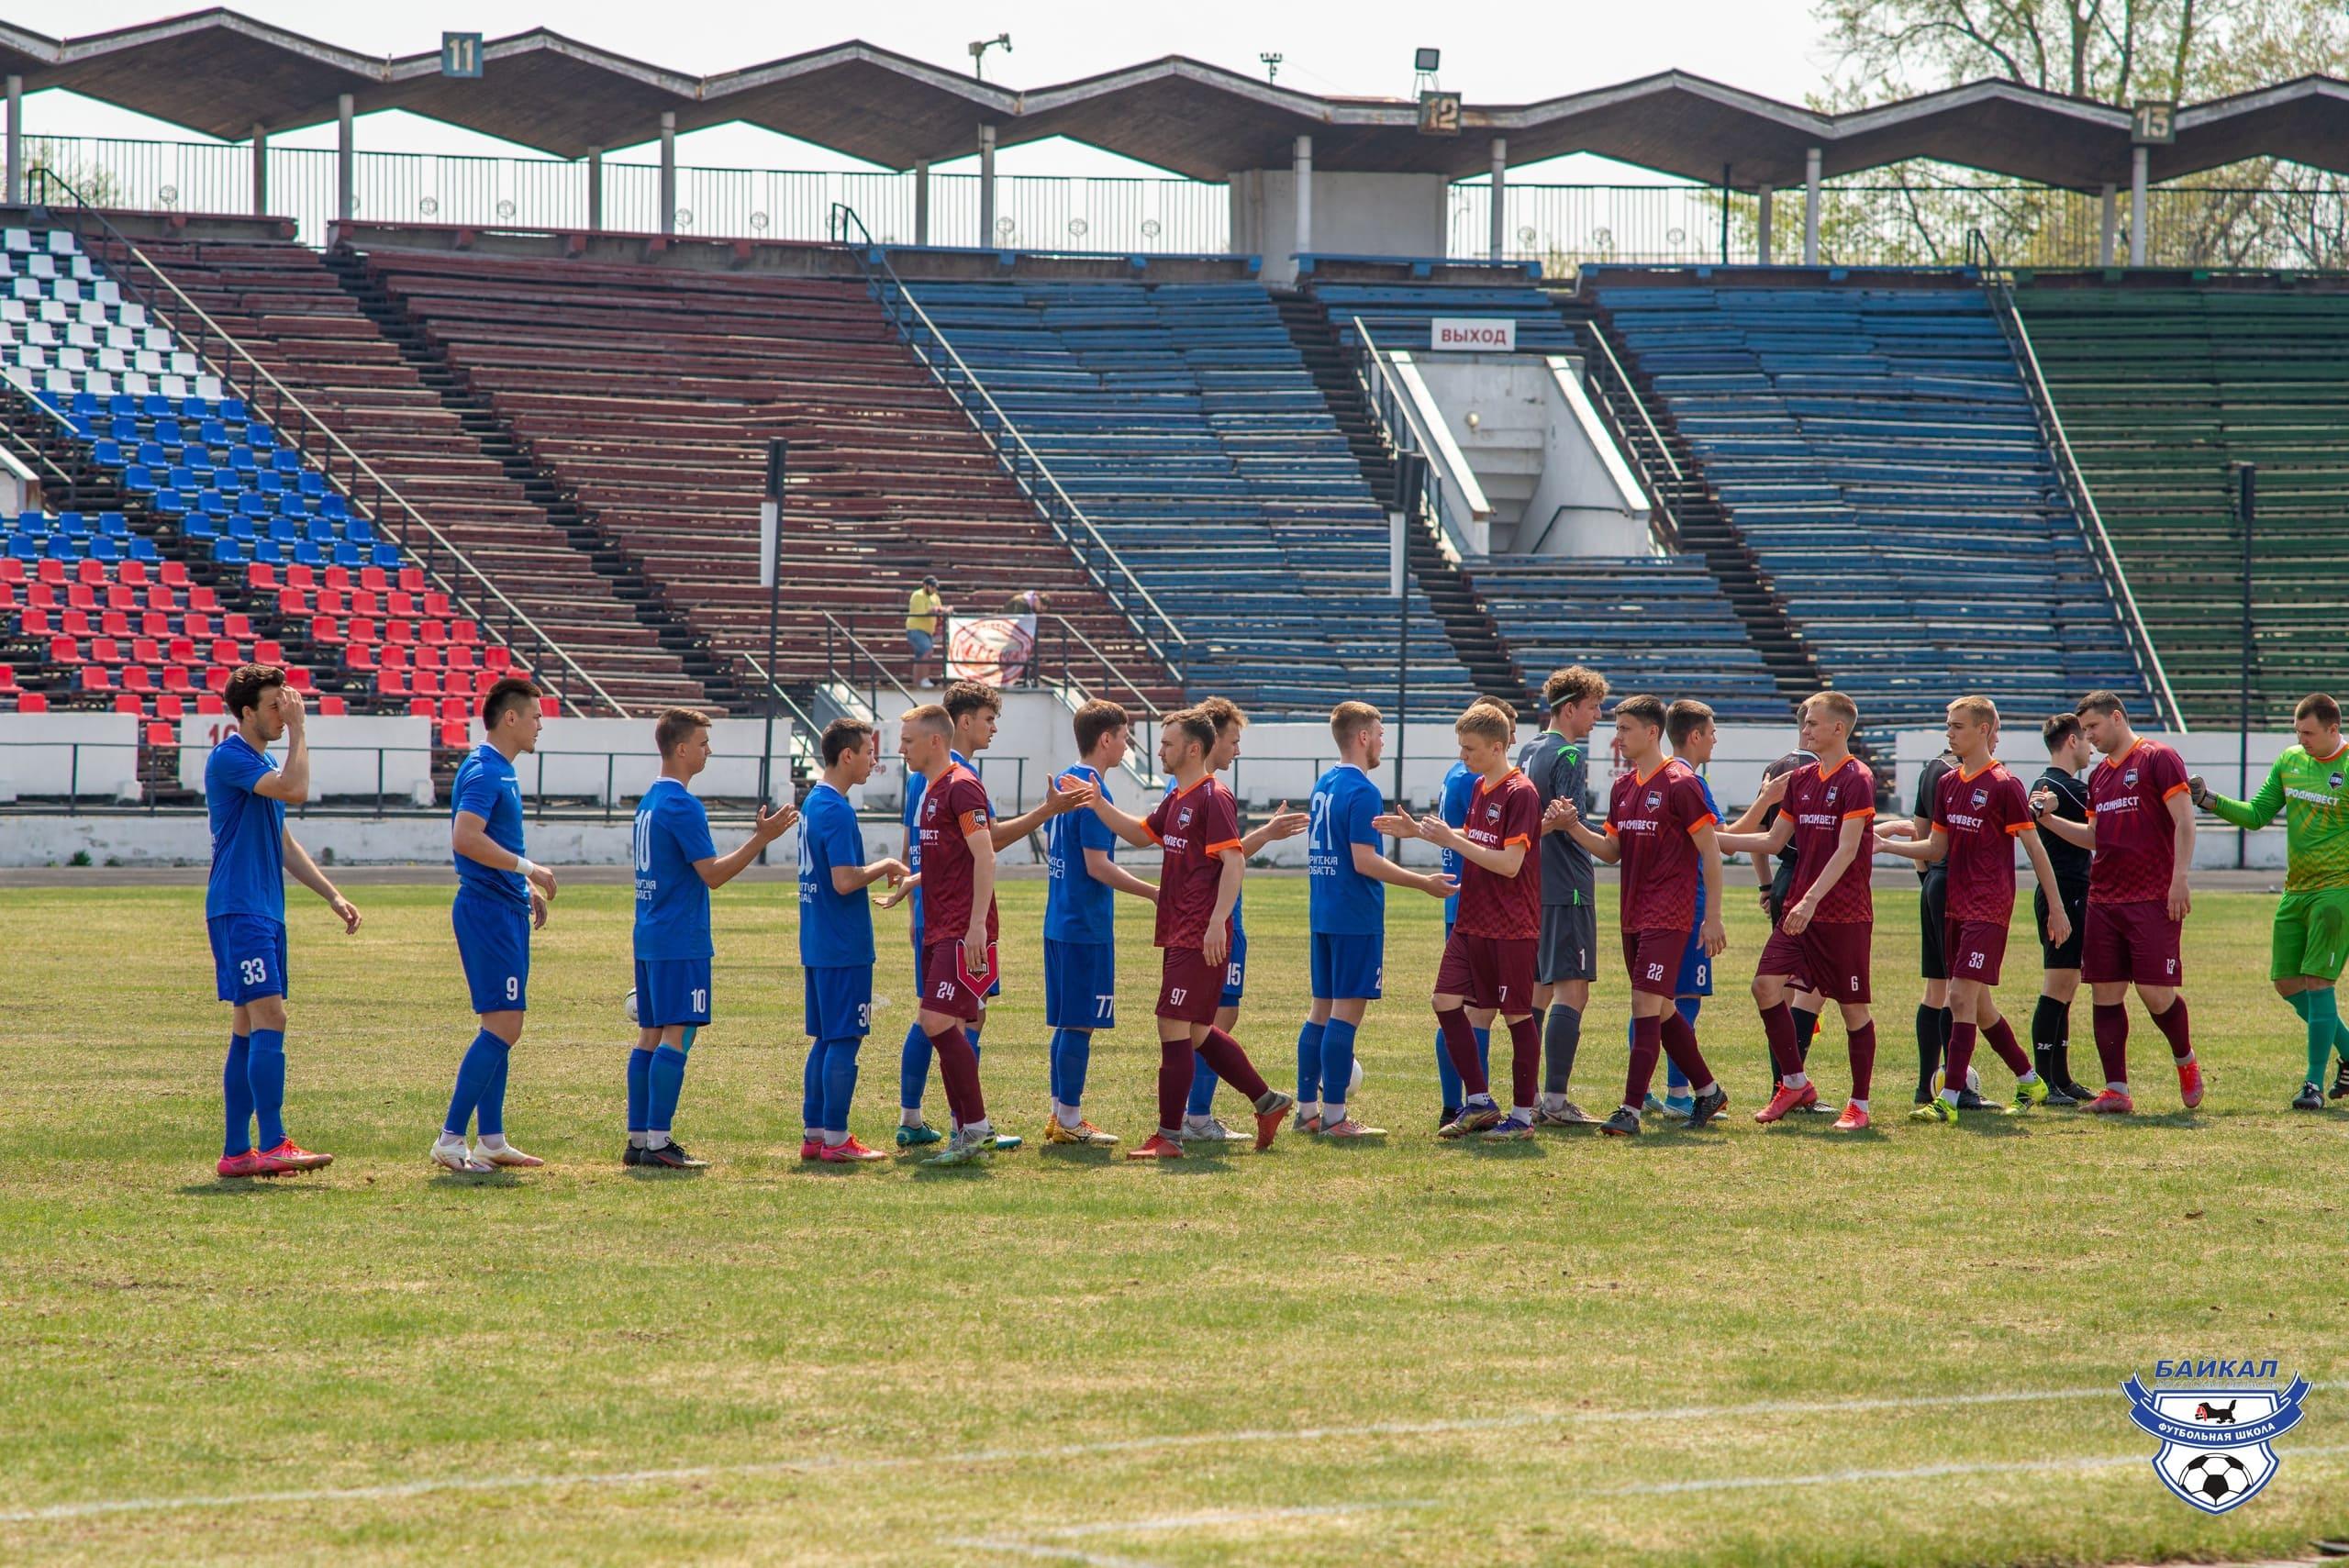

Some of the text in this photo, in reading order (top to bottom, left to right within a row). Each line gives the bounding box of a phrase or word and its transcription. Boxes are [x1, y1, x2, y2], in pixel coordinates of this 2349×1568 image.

[449, 39, 474, 72] 11
[1428, 98, 1459, 129] 12
[1441, 328, 1507, 345] ВЫХОД
[1309, 791, 1334, 851] 21
[635, 809, 652, 873] 10
[240, 957, 266, 985] 33
[1579, 948, 1586, 971] 1
[1968, 951, 1986, 970] 33
[1226, 962, 1241, 986] 15
[1646, 962, 1664, 982] 22
[1696, 964, 1707, 986] 8
[1851, 975, 1859, 992] 6
[507, 976, 518, 1001] 9
[936, 981, 955, 1001] 24
[1170, 987, 1187, 1006] 97
[691, 988, 707, 1013] 10
[1096, 995, 1114, 1018] 77
